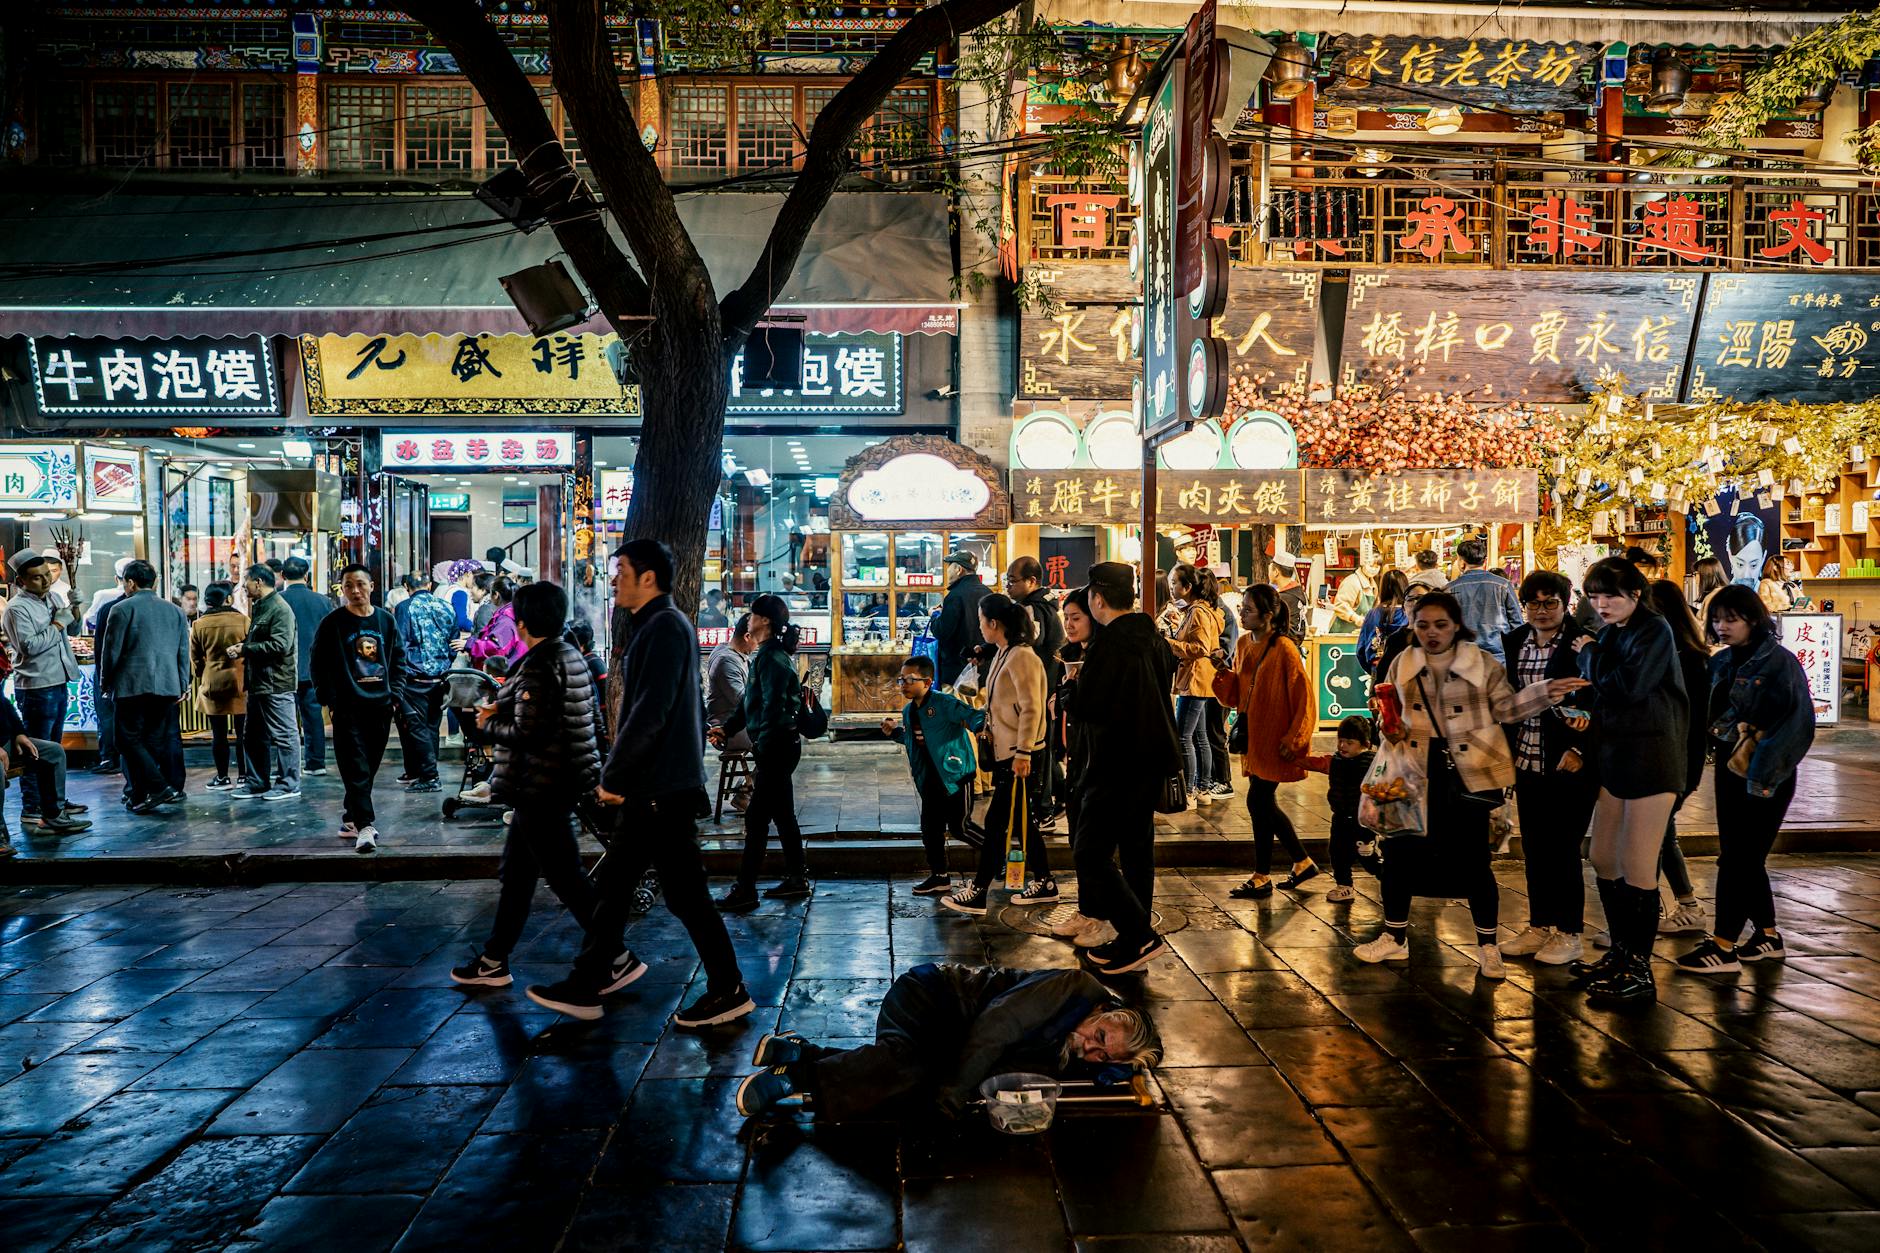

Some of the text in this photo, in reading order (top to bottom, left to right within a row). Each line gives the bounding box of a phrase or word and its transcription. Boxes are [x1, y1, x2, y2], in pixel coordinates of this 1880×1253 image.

[1357, 40, 1582, 89] 永信老茶坊
[1361, 310, 1677, 364] 橋梓口賈永信
[44, 347, 263, 402] 牛肉泡馍
[5, 472, 24, 494] 肉
[1025, 476, 1044, 518] 清真
[1319, 476, 1337, 518] 清真
